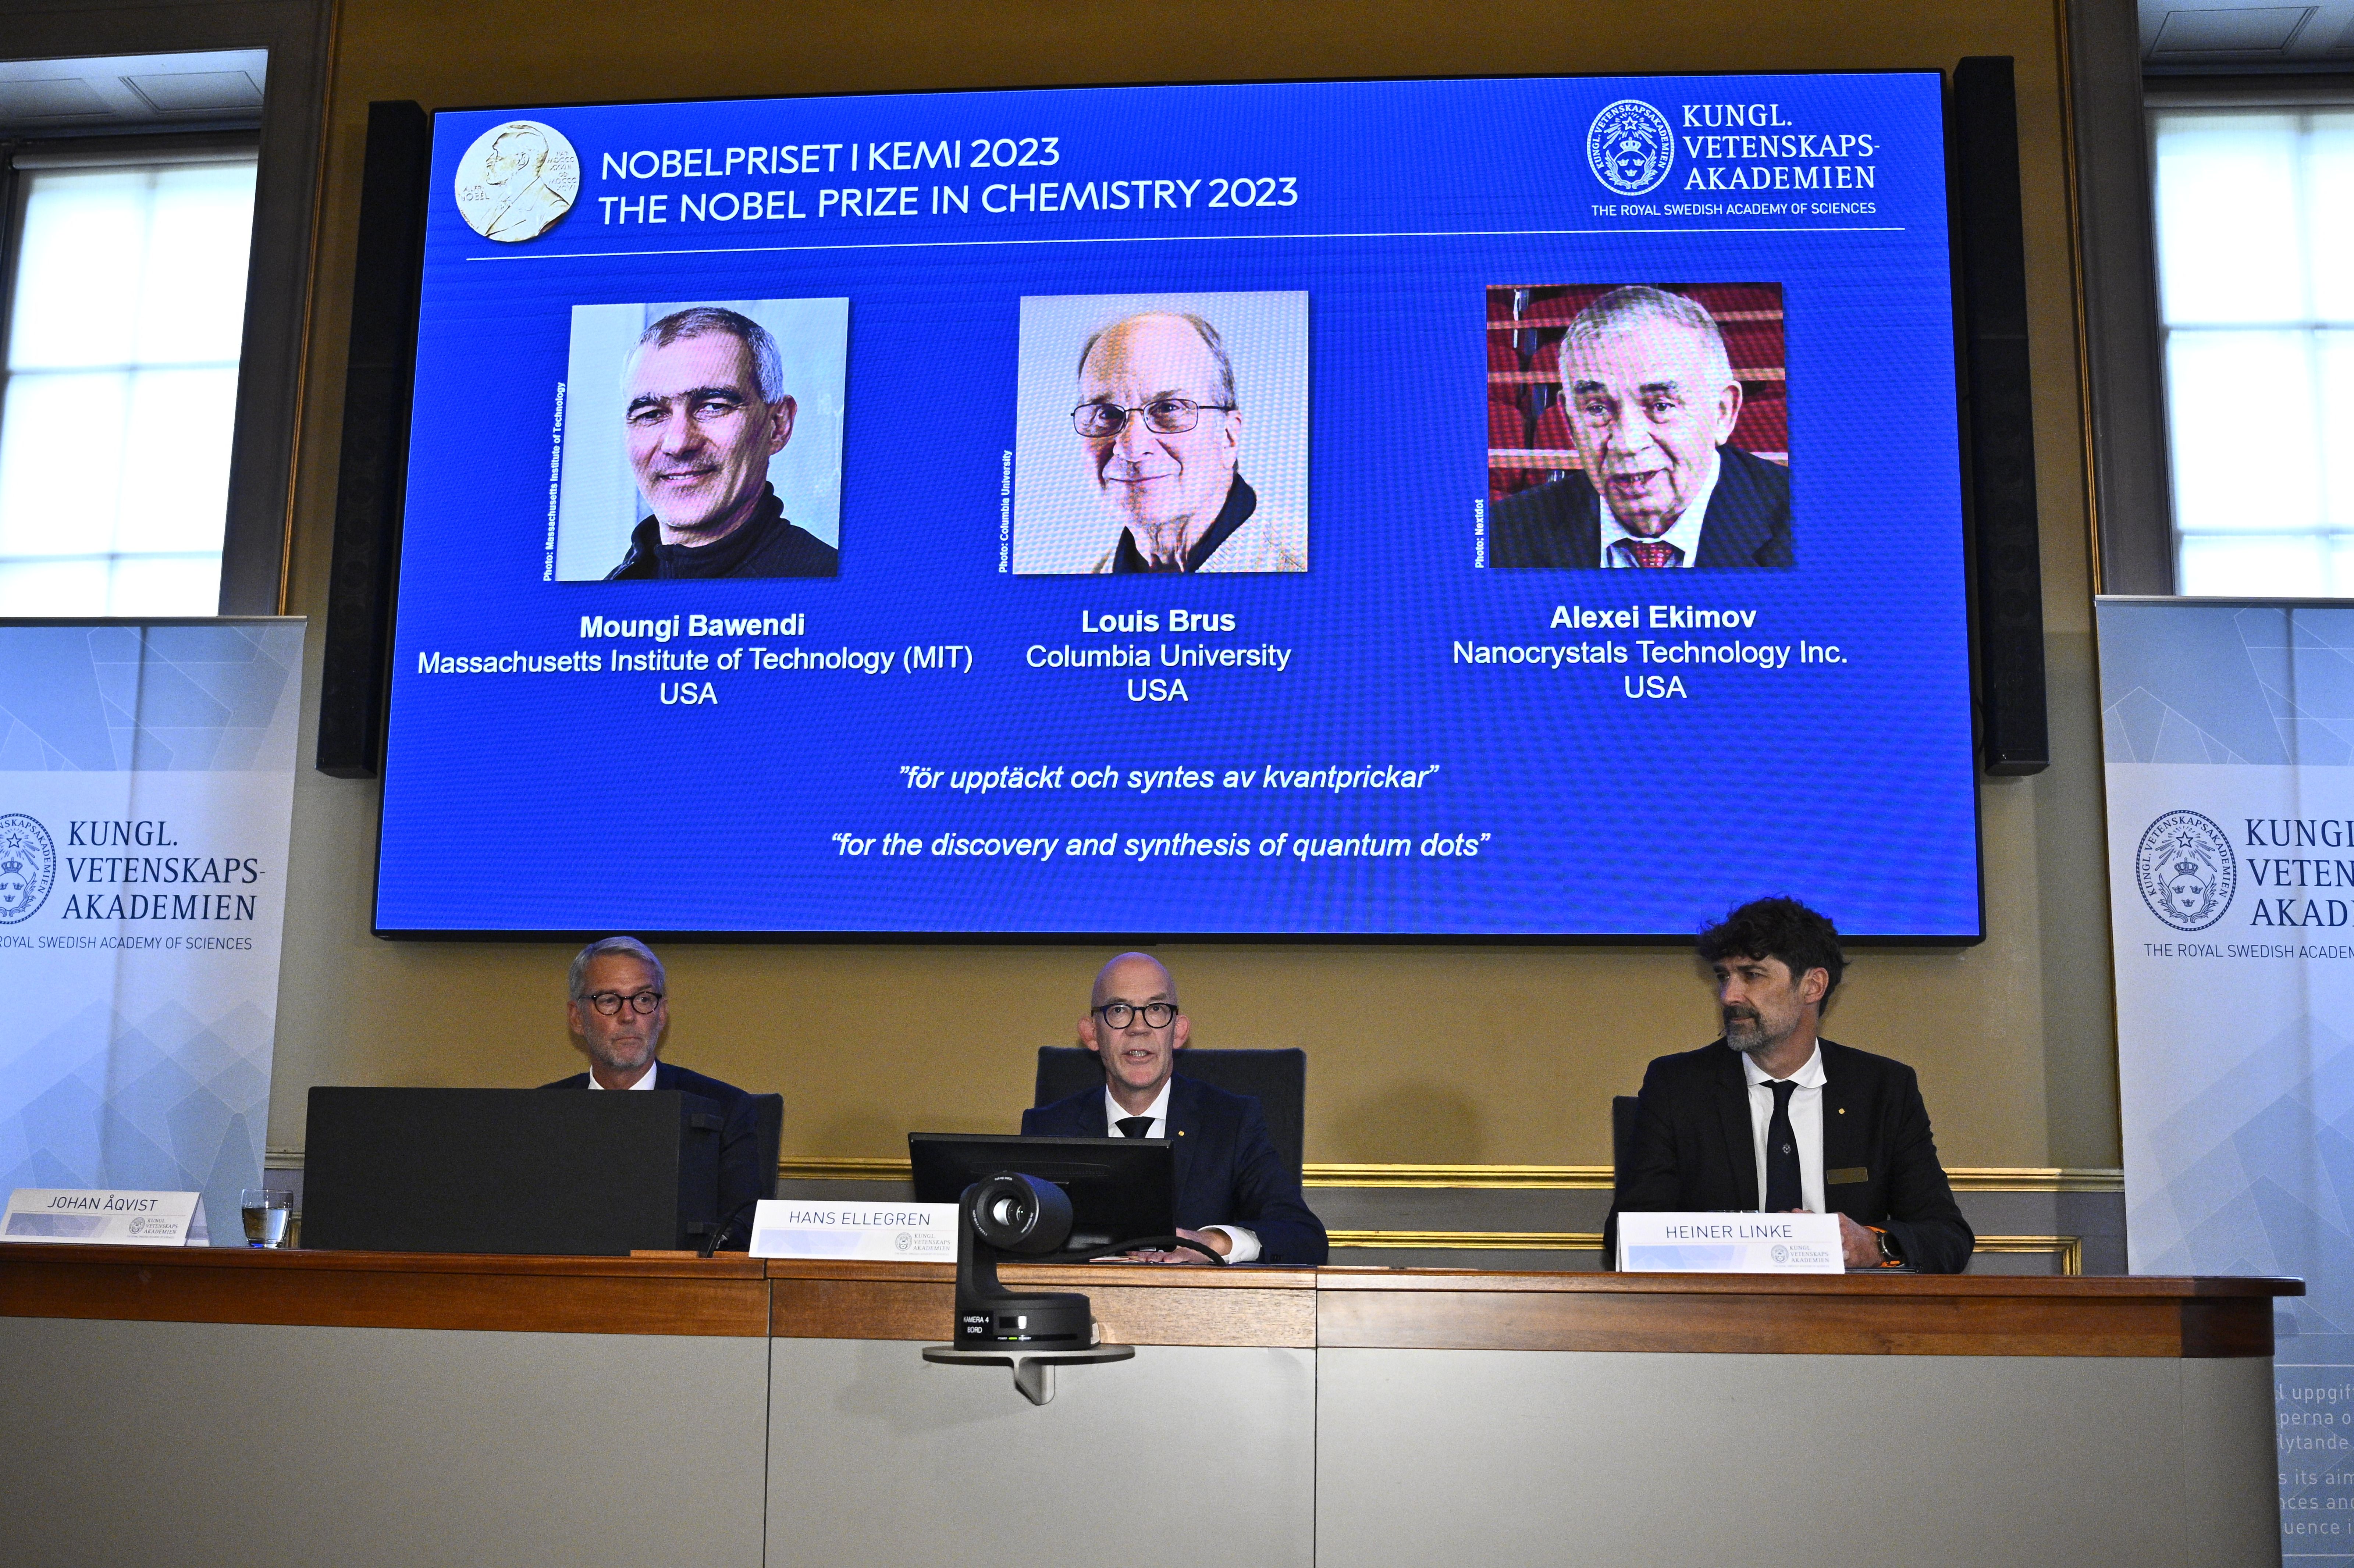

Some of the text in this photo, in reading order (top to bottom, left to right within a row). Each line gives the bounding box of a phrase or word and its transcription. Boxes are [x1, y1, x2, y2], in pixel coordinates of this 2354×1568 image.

[1682, 104, 1792, 127] KUNGL.
[1592, 104, 1669, 169] KUNGL. VETENSKAPSAKADEMIEN
[1682, 134, 1880, 158] VETENSKAPS-
[602, 137, 1059, 180] NOBELPRISET I KEMI 2023
[1684, 166, 1875, 190] AKADEMIEN
[598, 177, 1298, 225] THE NOBEL PRIZE IN CHEMISTRY 2023
[1591, 202, 1876, 216] THE ROYAL SWEDISH ACADEMY OF SCIENCES
[543, 382, 567, 581] Photo: Massachusetts Institute of Technology
[999, 450, 1013, 573] Photo: Columbia University
[1474, 499, 1484, 568] Photo: Nextdot
[580, 613, 805, 642] Moungi Bawendi
[1082, 609, 1235, 632] Louis Brus
[1550, 605, 1757, 628] Alexei Ekimov
[418, 645, 972, 674] Massachusetts Institute of Technology (MIT)
[1026, 644, 1292, 671] Columbia University
[1454, 640, 1847, 669] Nanocrystals Technology Inc.
[660, 682, 718, 705] USA
[1128, 678, 1189, 701] USA
[1625, 676, 1687, 698] USA
[950, 765, 1064, 794] upptäckt
[1071, 765, 1119, 788] och
[1127, 765, 1215, 794] syntes
[1223, 771, 1256, 788] av
[67, 821, 178, 846] KUNGL.
[882, 833, 922, 856] the
[931, 833, 1059, 862] discovery
[1066, 833, 1118, 856] and
[1124, 833, 1251, 862] synthesis
[1259, 833, 1289, 856] of
[1293, 833, 1411, 862] quantum
[2142, 816, 2231, 898] KUNGL. VETENSKAPSAKADEMIEN
[65, 857, 266, 884] VETENSKAPS-
[2245, 859, 2354, 887] VETEN
[61, 894, 258, 920] AKADEMIEN
[2249, 898, 2354, 927] AKAD
[38, 936, 96, 948] SWEDISH
[100, 937, 162, 949] ACADEMY
[166, 937, 183, 949] OF
[186, 937, 252, 950] SCIENCES
[2143, 943, 2173, 957] THE
[2178, 944, 2224, 957] ROYAL
[2227, 944, 2294, 958] SWEDISH
[47, 1194, 159, 1211] JOHAN ÅQVIST
[790, 1211, 930, 1225] HANS ELLEGREN
[1667, 1225, 1792, 1239] HEINER LINKE
[2293, 1384, 2354, 1404] uppgif
[2296, 1469, 2317, 1485] its
